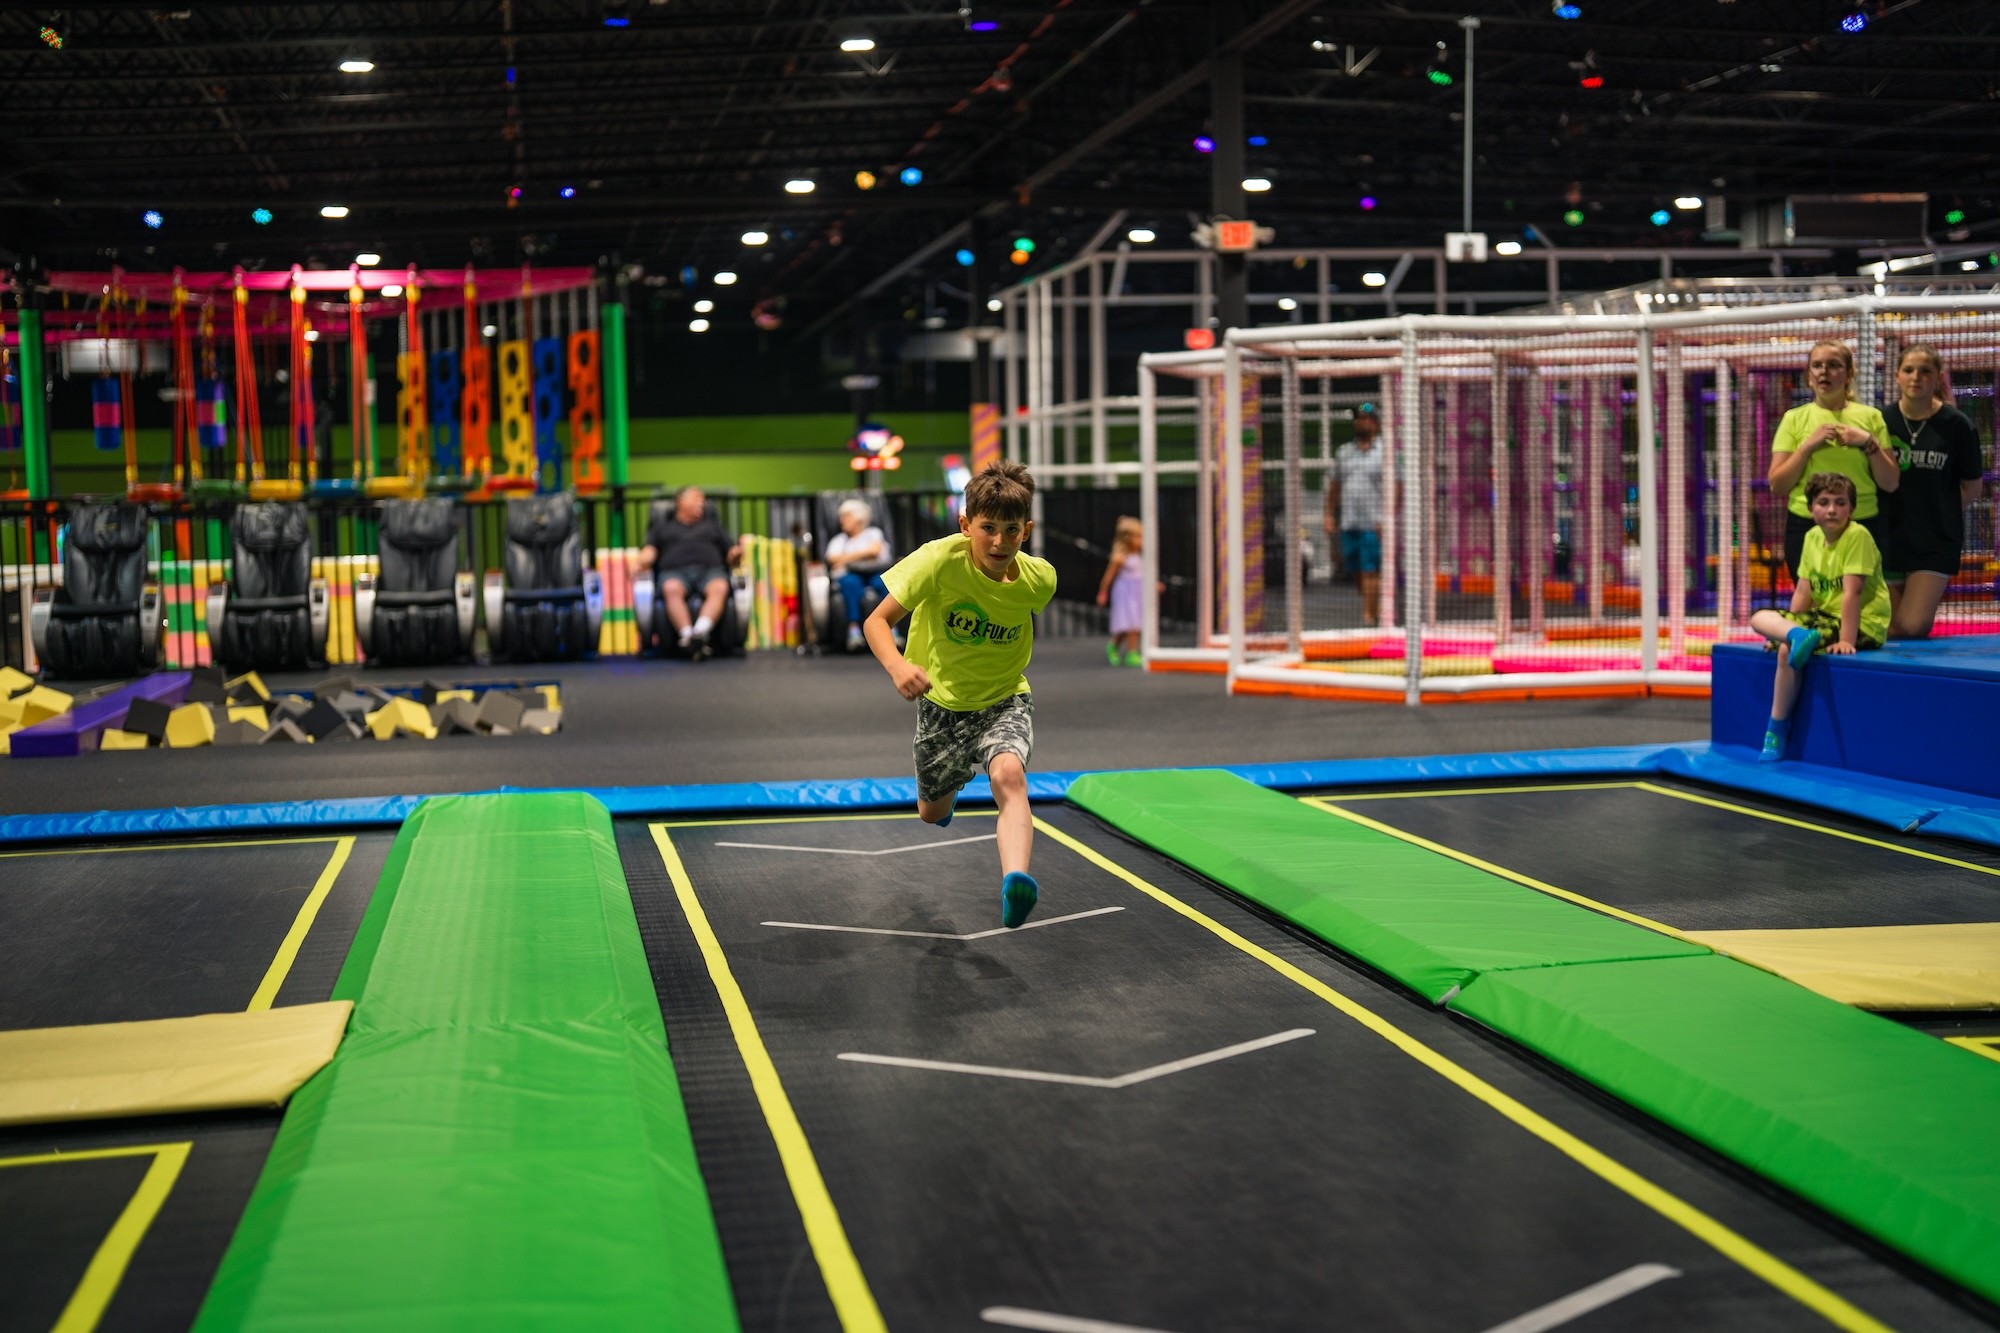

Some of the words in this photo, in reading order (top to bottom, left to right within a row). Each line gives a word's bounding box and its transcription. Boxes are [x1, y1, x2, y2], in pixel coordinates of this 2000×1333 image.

[1908, 450, 1926, 465] FUN
[1927, 450, 1948, 470] CITY
[983, 622, 1008, 639] FUN
